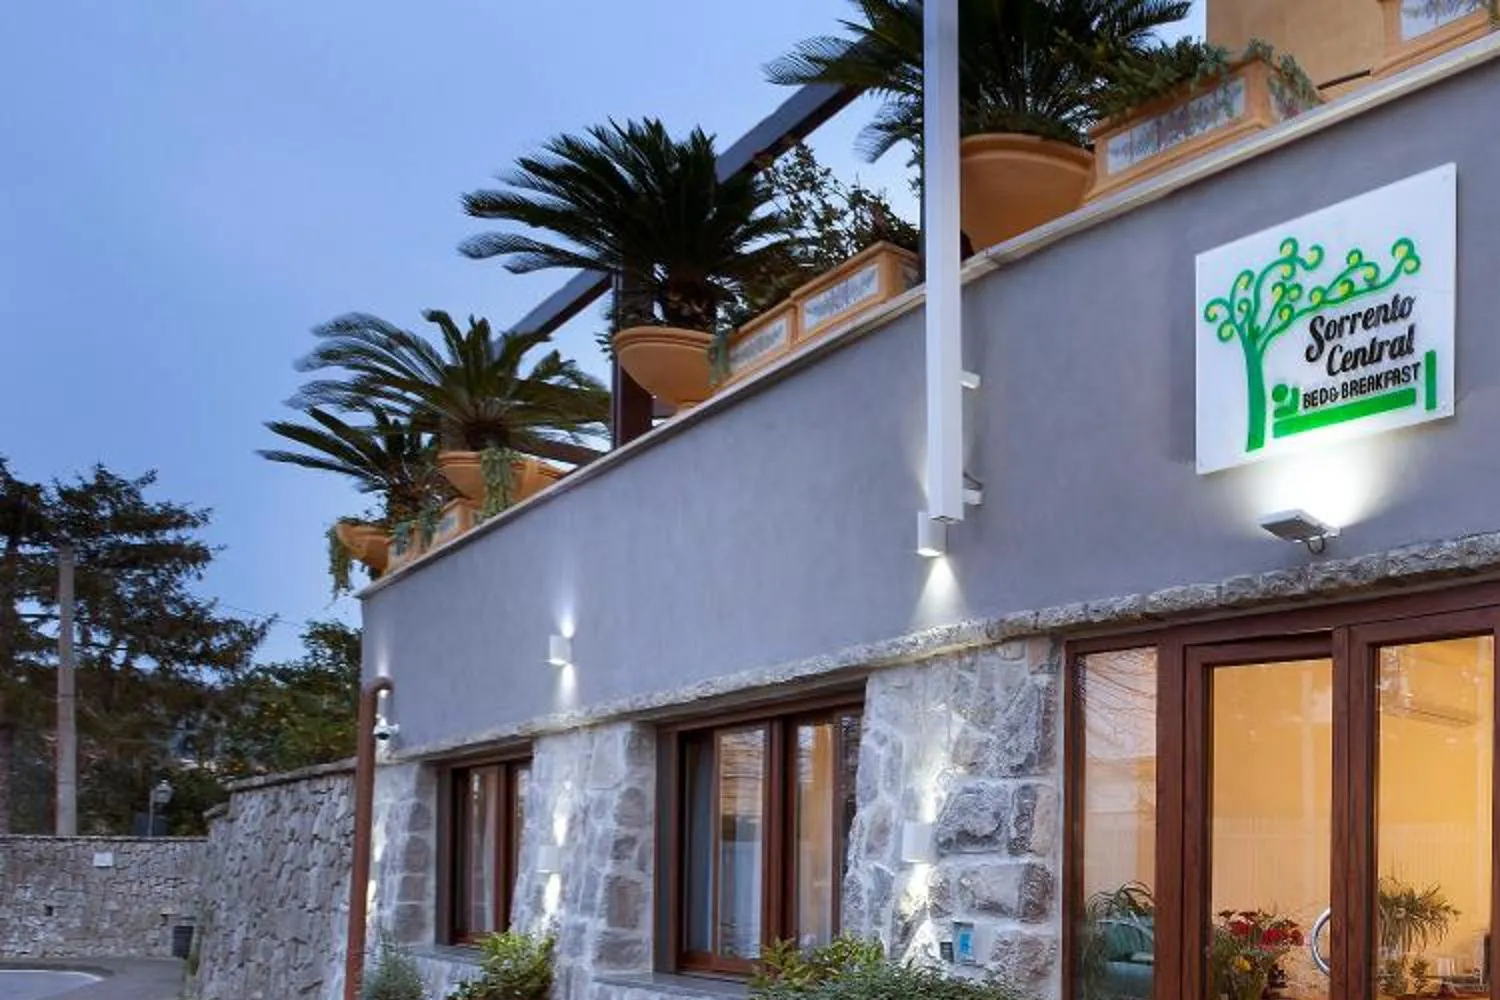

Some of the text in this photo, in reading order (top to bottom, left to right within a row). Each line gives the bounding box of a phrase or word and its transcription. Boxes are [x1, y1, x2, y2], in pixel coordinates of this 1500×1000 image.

[1305, 294, 1416, 362] Sorrento
[1326, 323, 1415, 376] Central
[1341, 361, 1421, 399] BREAKFAST
